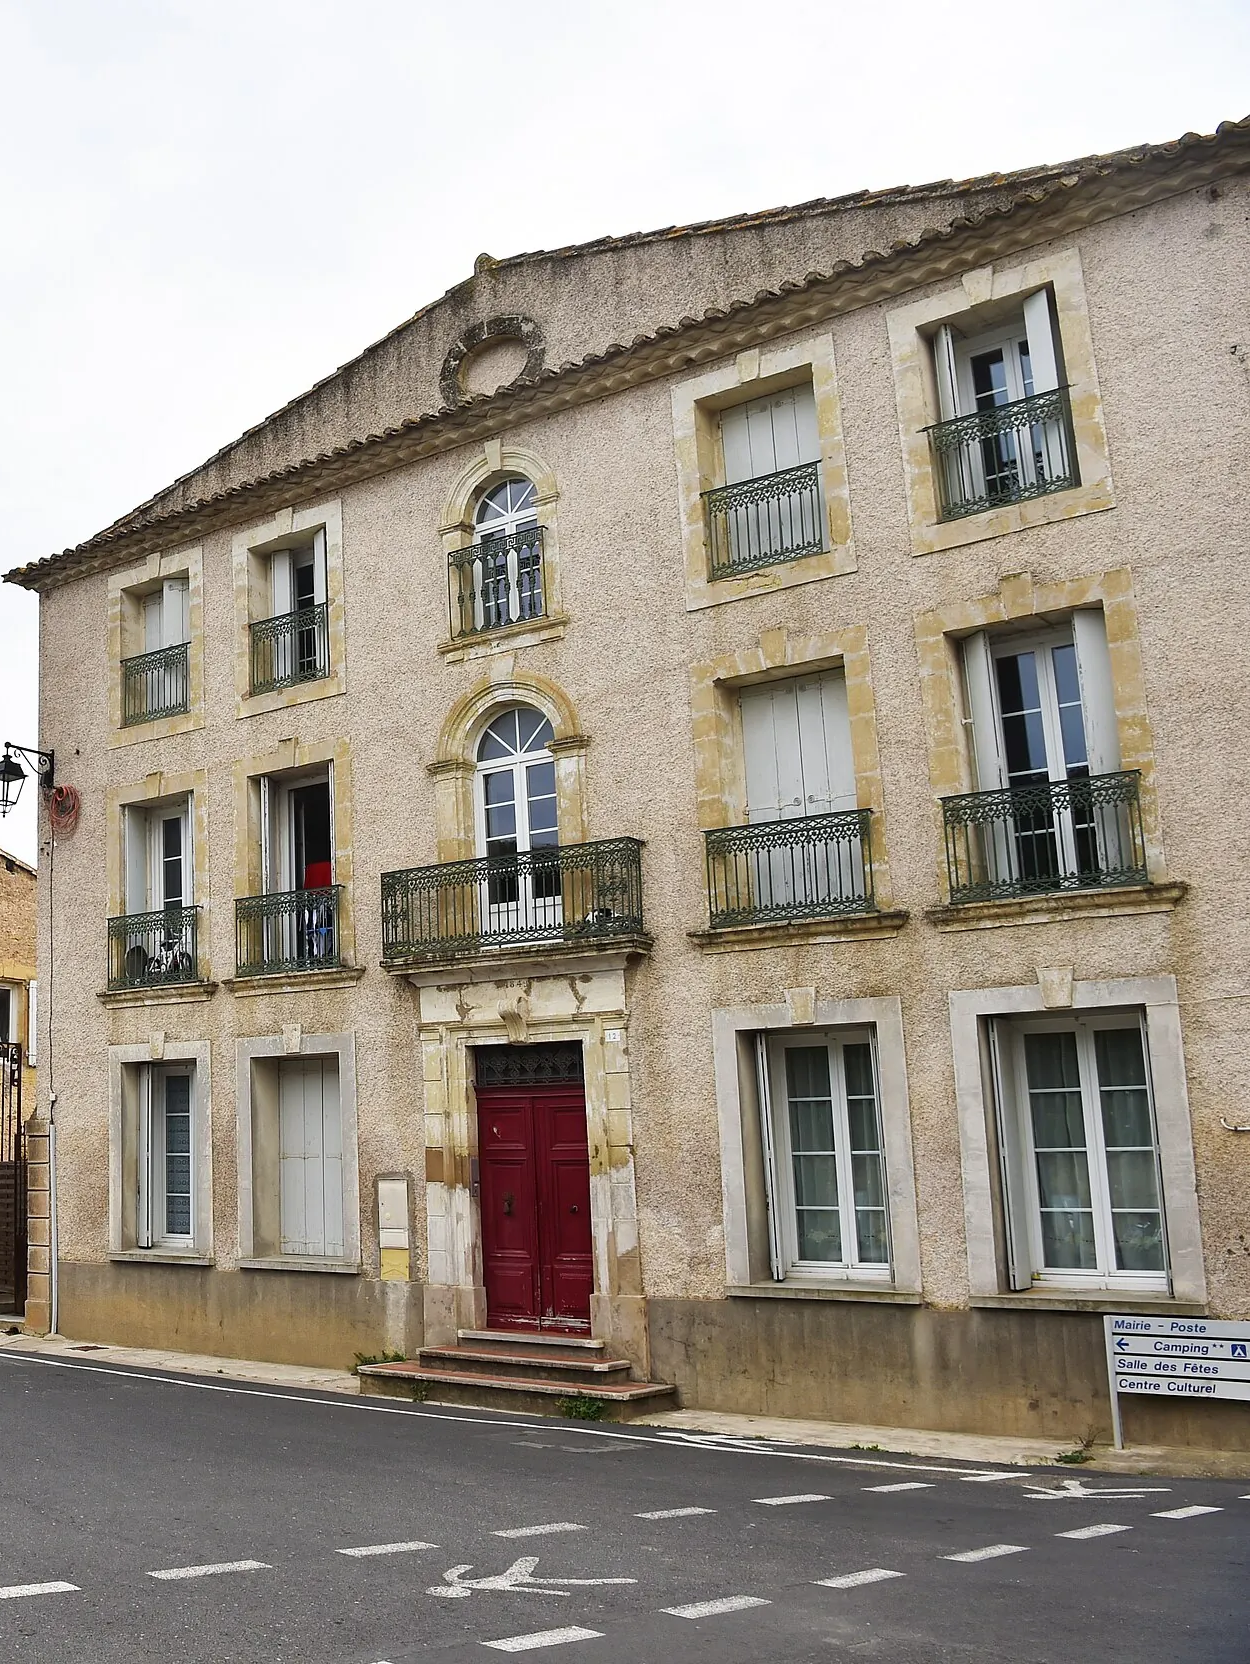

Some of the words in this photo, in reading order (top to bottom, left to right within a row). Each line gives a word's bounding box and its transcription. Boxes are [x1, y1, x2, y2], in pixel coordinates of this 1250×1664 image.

[607, 1032, 617, 1040] 12
[1114, 1320, 1152, 1331] Mairie
[1170, 1322, 1207, 1333] Poste
[1153, 1341, 1209, 1355] Camping
[1117, 1358, 1148, 1370] Salle
[1154, 1361, 1177, 1372] des
[1183, 1363, 1219, 1374] Fêtes
[1119, 1379, 1161, 1390] Centre
[1167, 1381, 1216, 1393] Culturel
